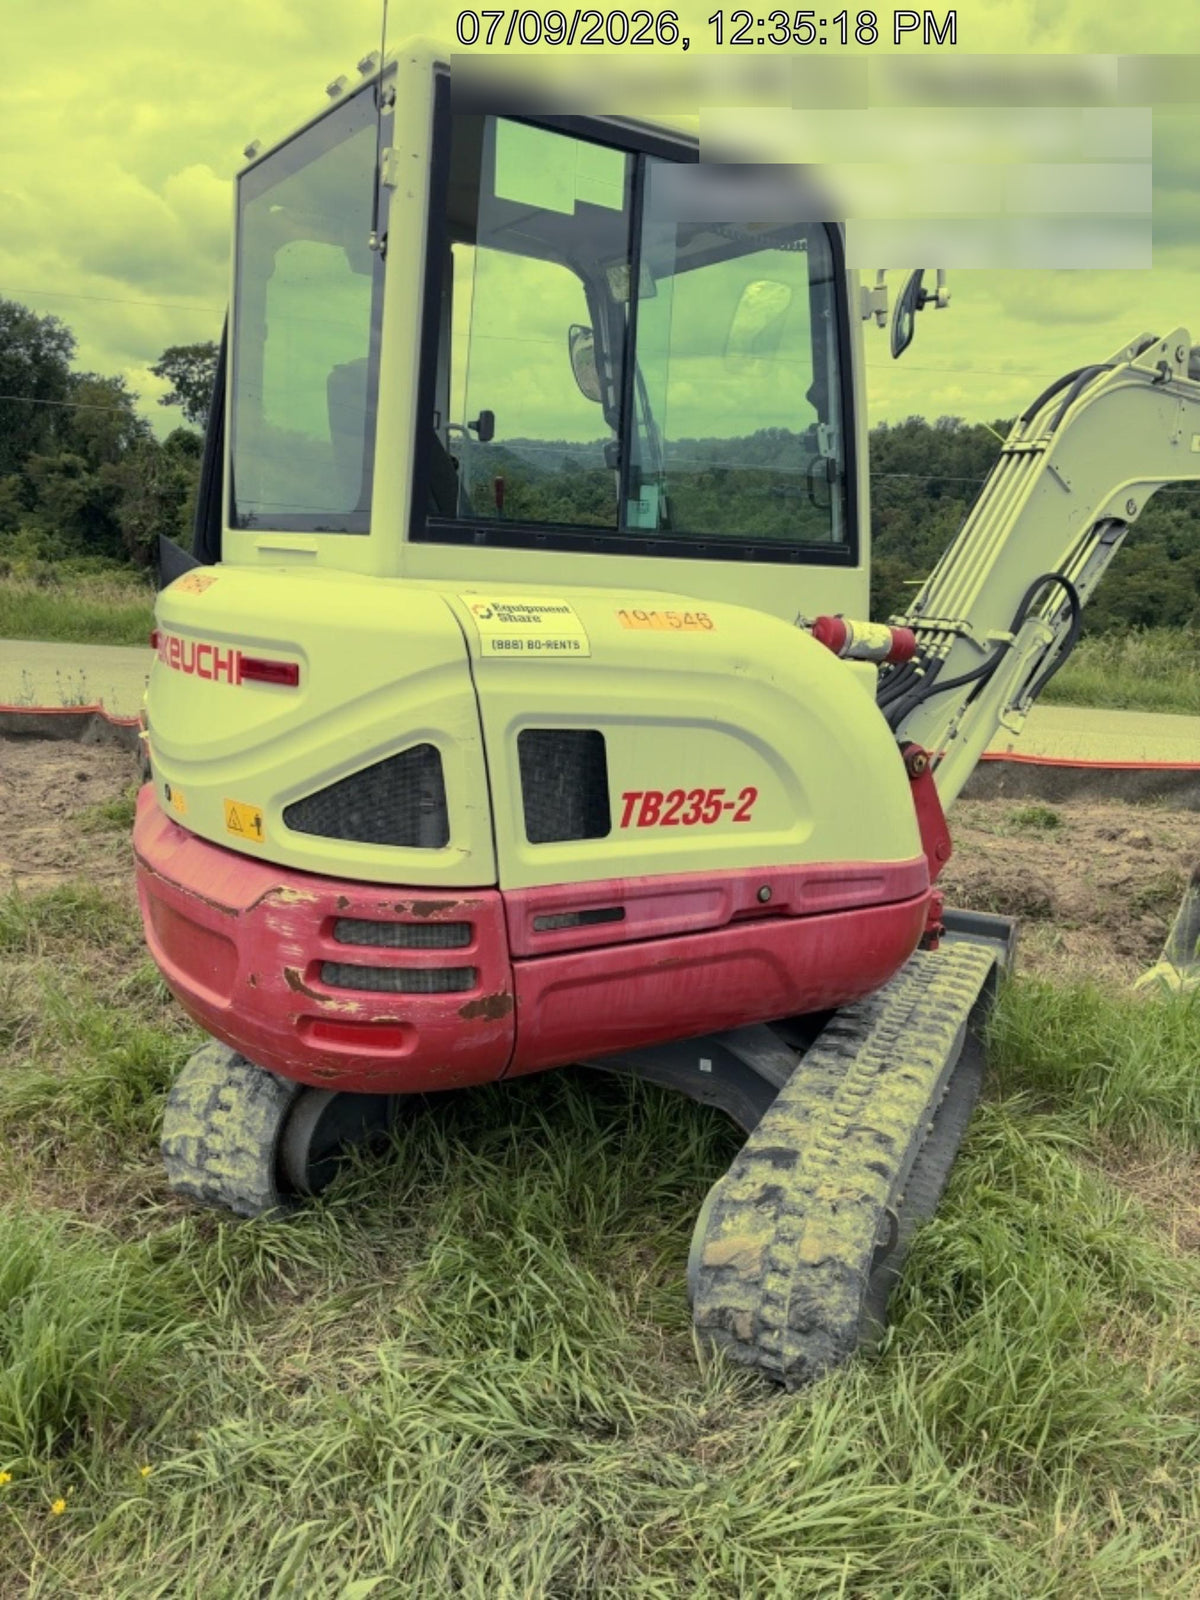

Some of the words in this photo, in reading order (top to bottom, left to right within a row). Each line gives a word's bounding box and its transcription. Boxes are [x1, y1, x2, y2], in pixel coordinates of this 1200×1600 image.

[491, 603, 570, 614] Equipment
[497, 613, 542, 623] Share
[491, 640, 524, 651] (888)
[620, 786, 758, 828] TB235-2
